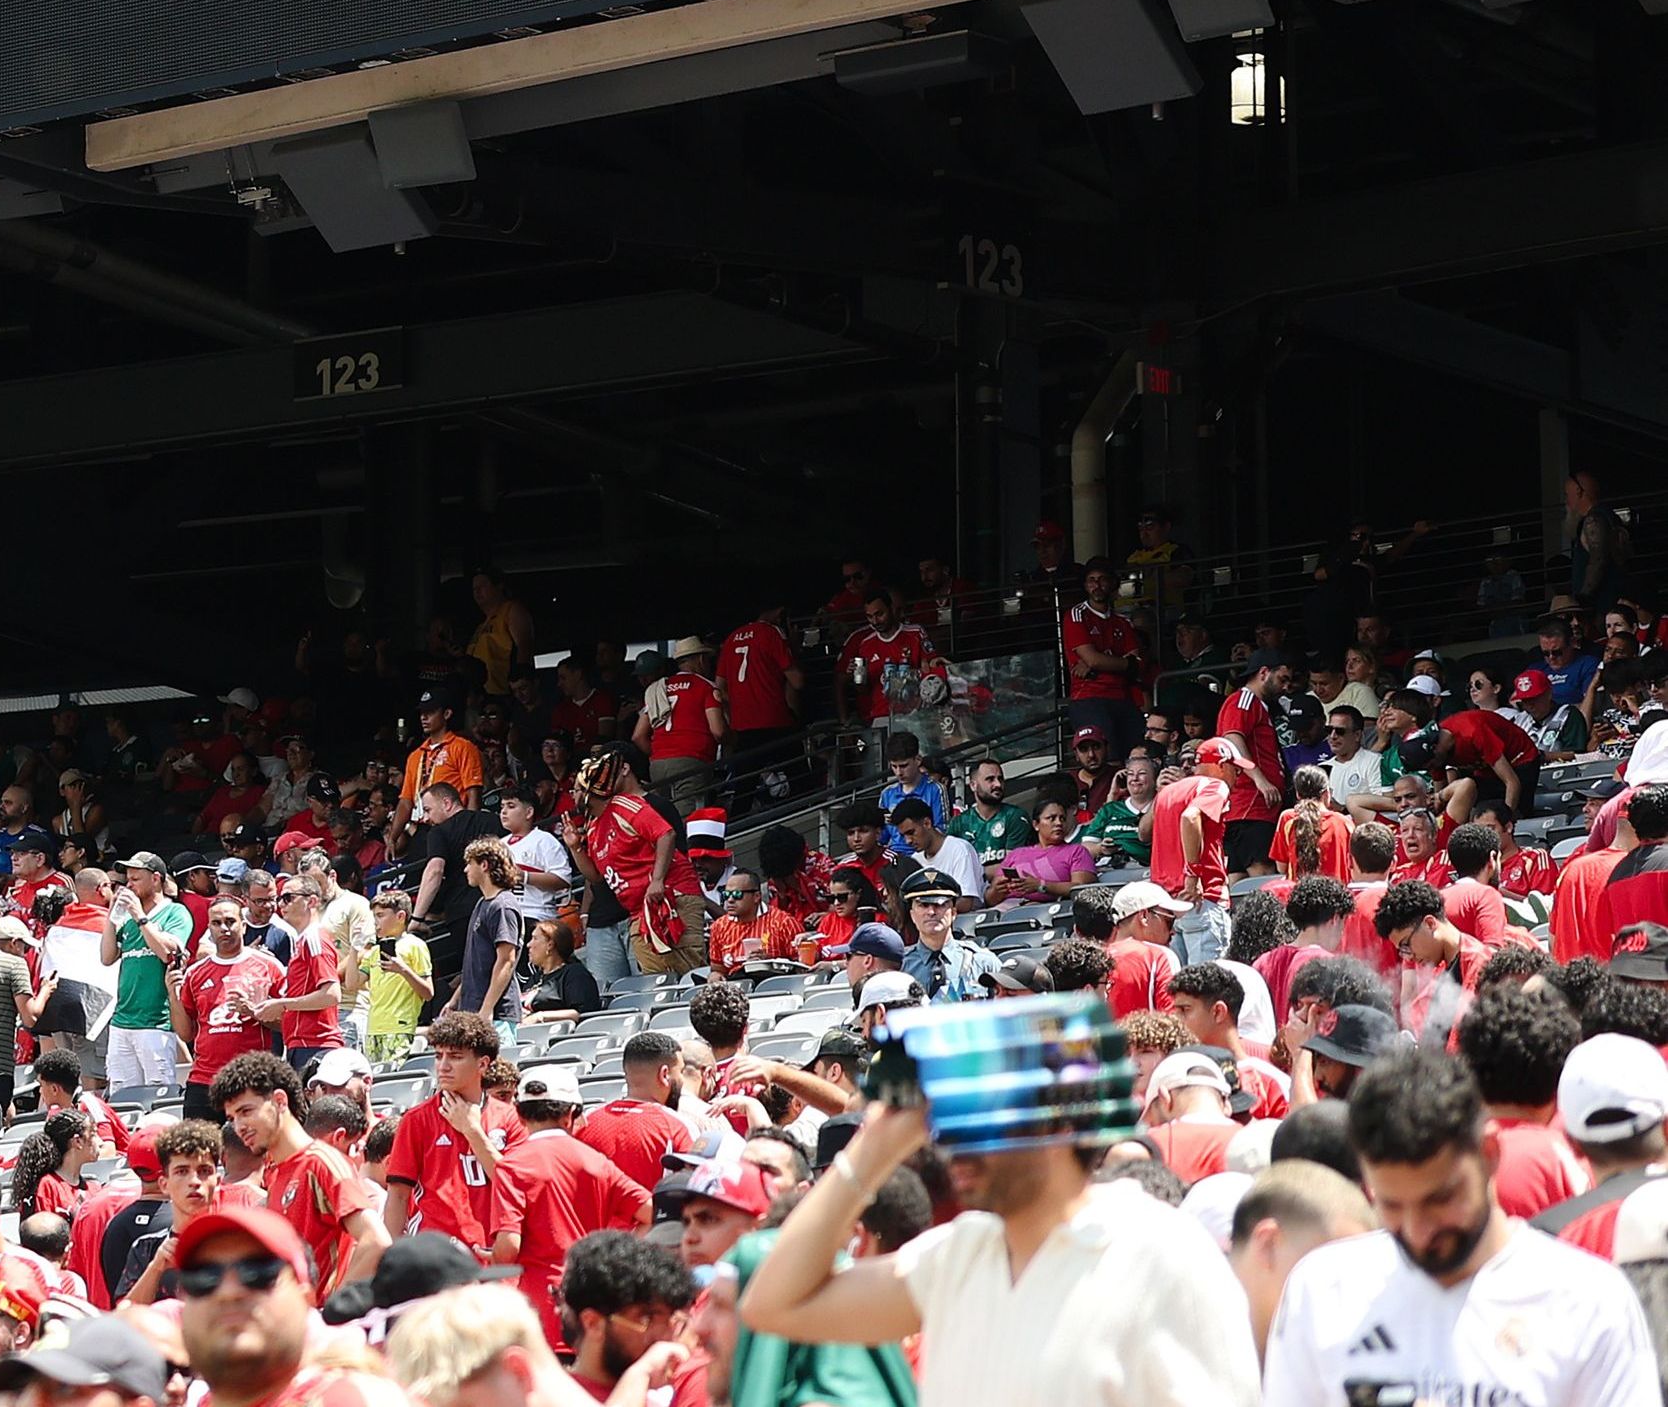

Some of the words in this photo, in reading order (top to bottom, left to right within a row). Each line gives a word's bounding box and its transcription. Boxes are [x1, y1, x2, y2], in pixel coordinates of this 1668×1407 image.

[957, 234, 1024, 298] 123
[316, 351, 381, 396] 123
[733, 630, 754, 642] ALAA
[734, 645, 749, 682] 7
[666, 681, 691, 693] SSAM
[458, 1152, 487, 1187] 10
